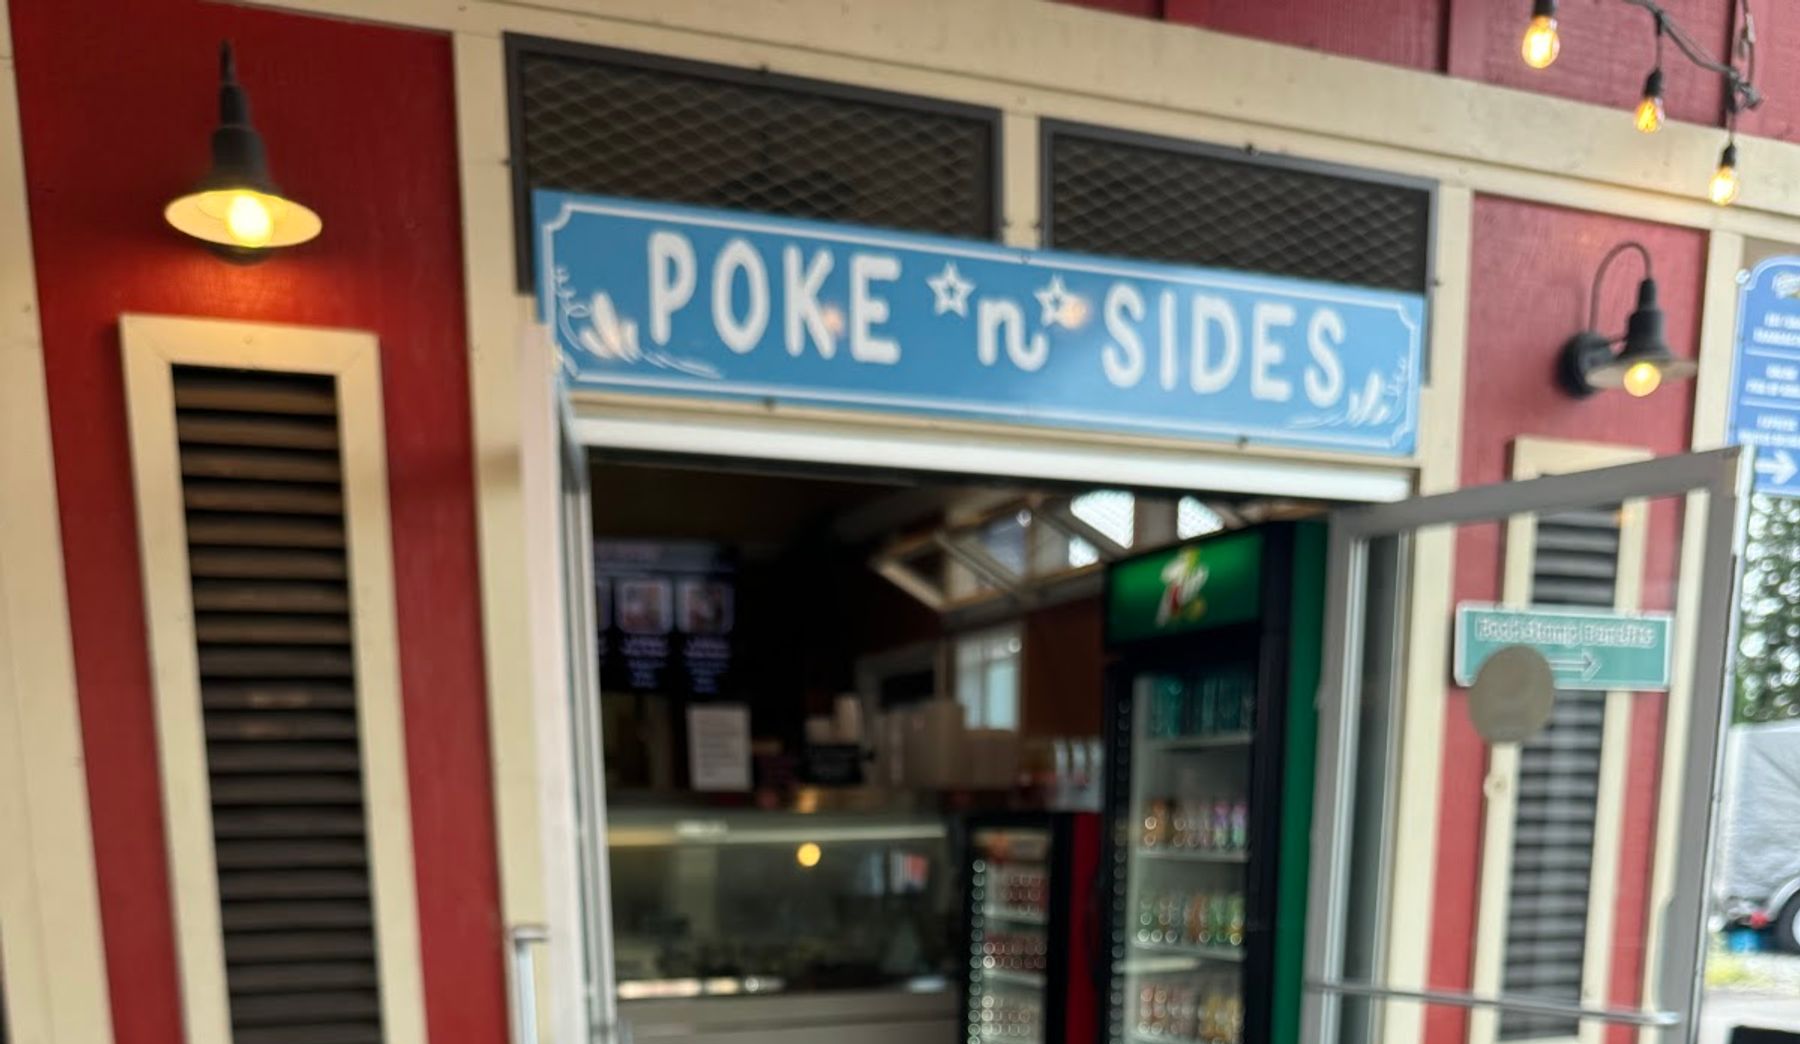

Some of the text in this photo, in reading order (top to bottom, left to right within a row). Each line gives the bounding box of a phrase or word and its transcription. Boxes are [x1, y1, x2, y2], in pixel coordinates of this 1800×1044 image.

[647, 231, 902, 365] POKE
[1101, 283, 1345, 409] SIDES
[1582, 623, 1655, 649] Benefits
